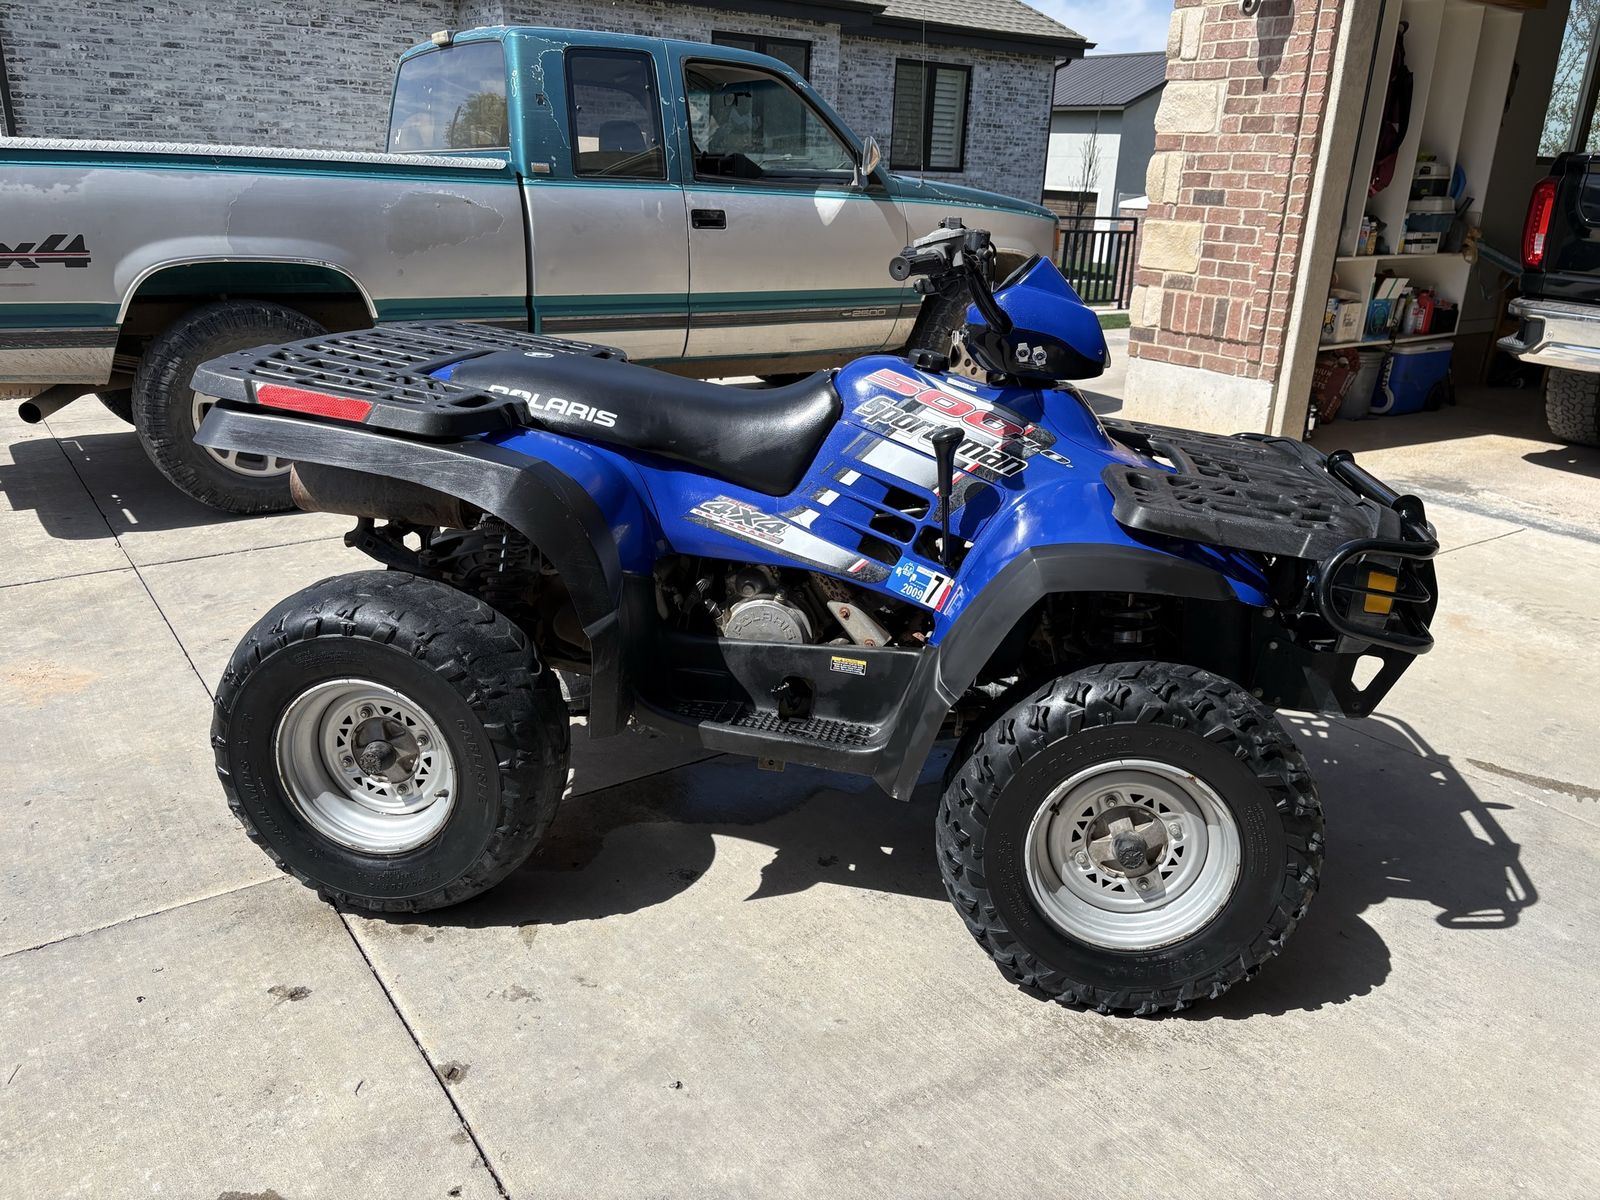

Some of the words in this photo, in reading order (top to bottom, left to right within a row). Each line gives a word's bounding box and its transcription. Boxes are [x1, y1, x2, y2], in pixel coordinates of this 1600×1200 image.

[864, 368, 1025, 438] 500
[853, 395, 1029, 478] Sportman
[900, 583, 924, 600] 2009
[925, 575, 945, 604] 7
